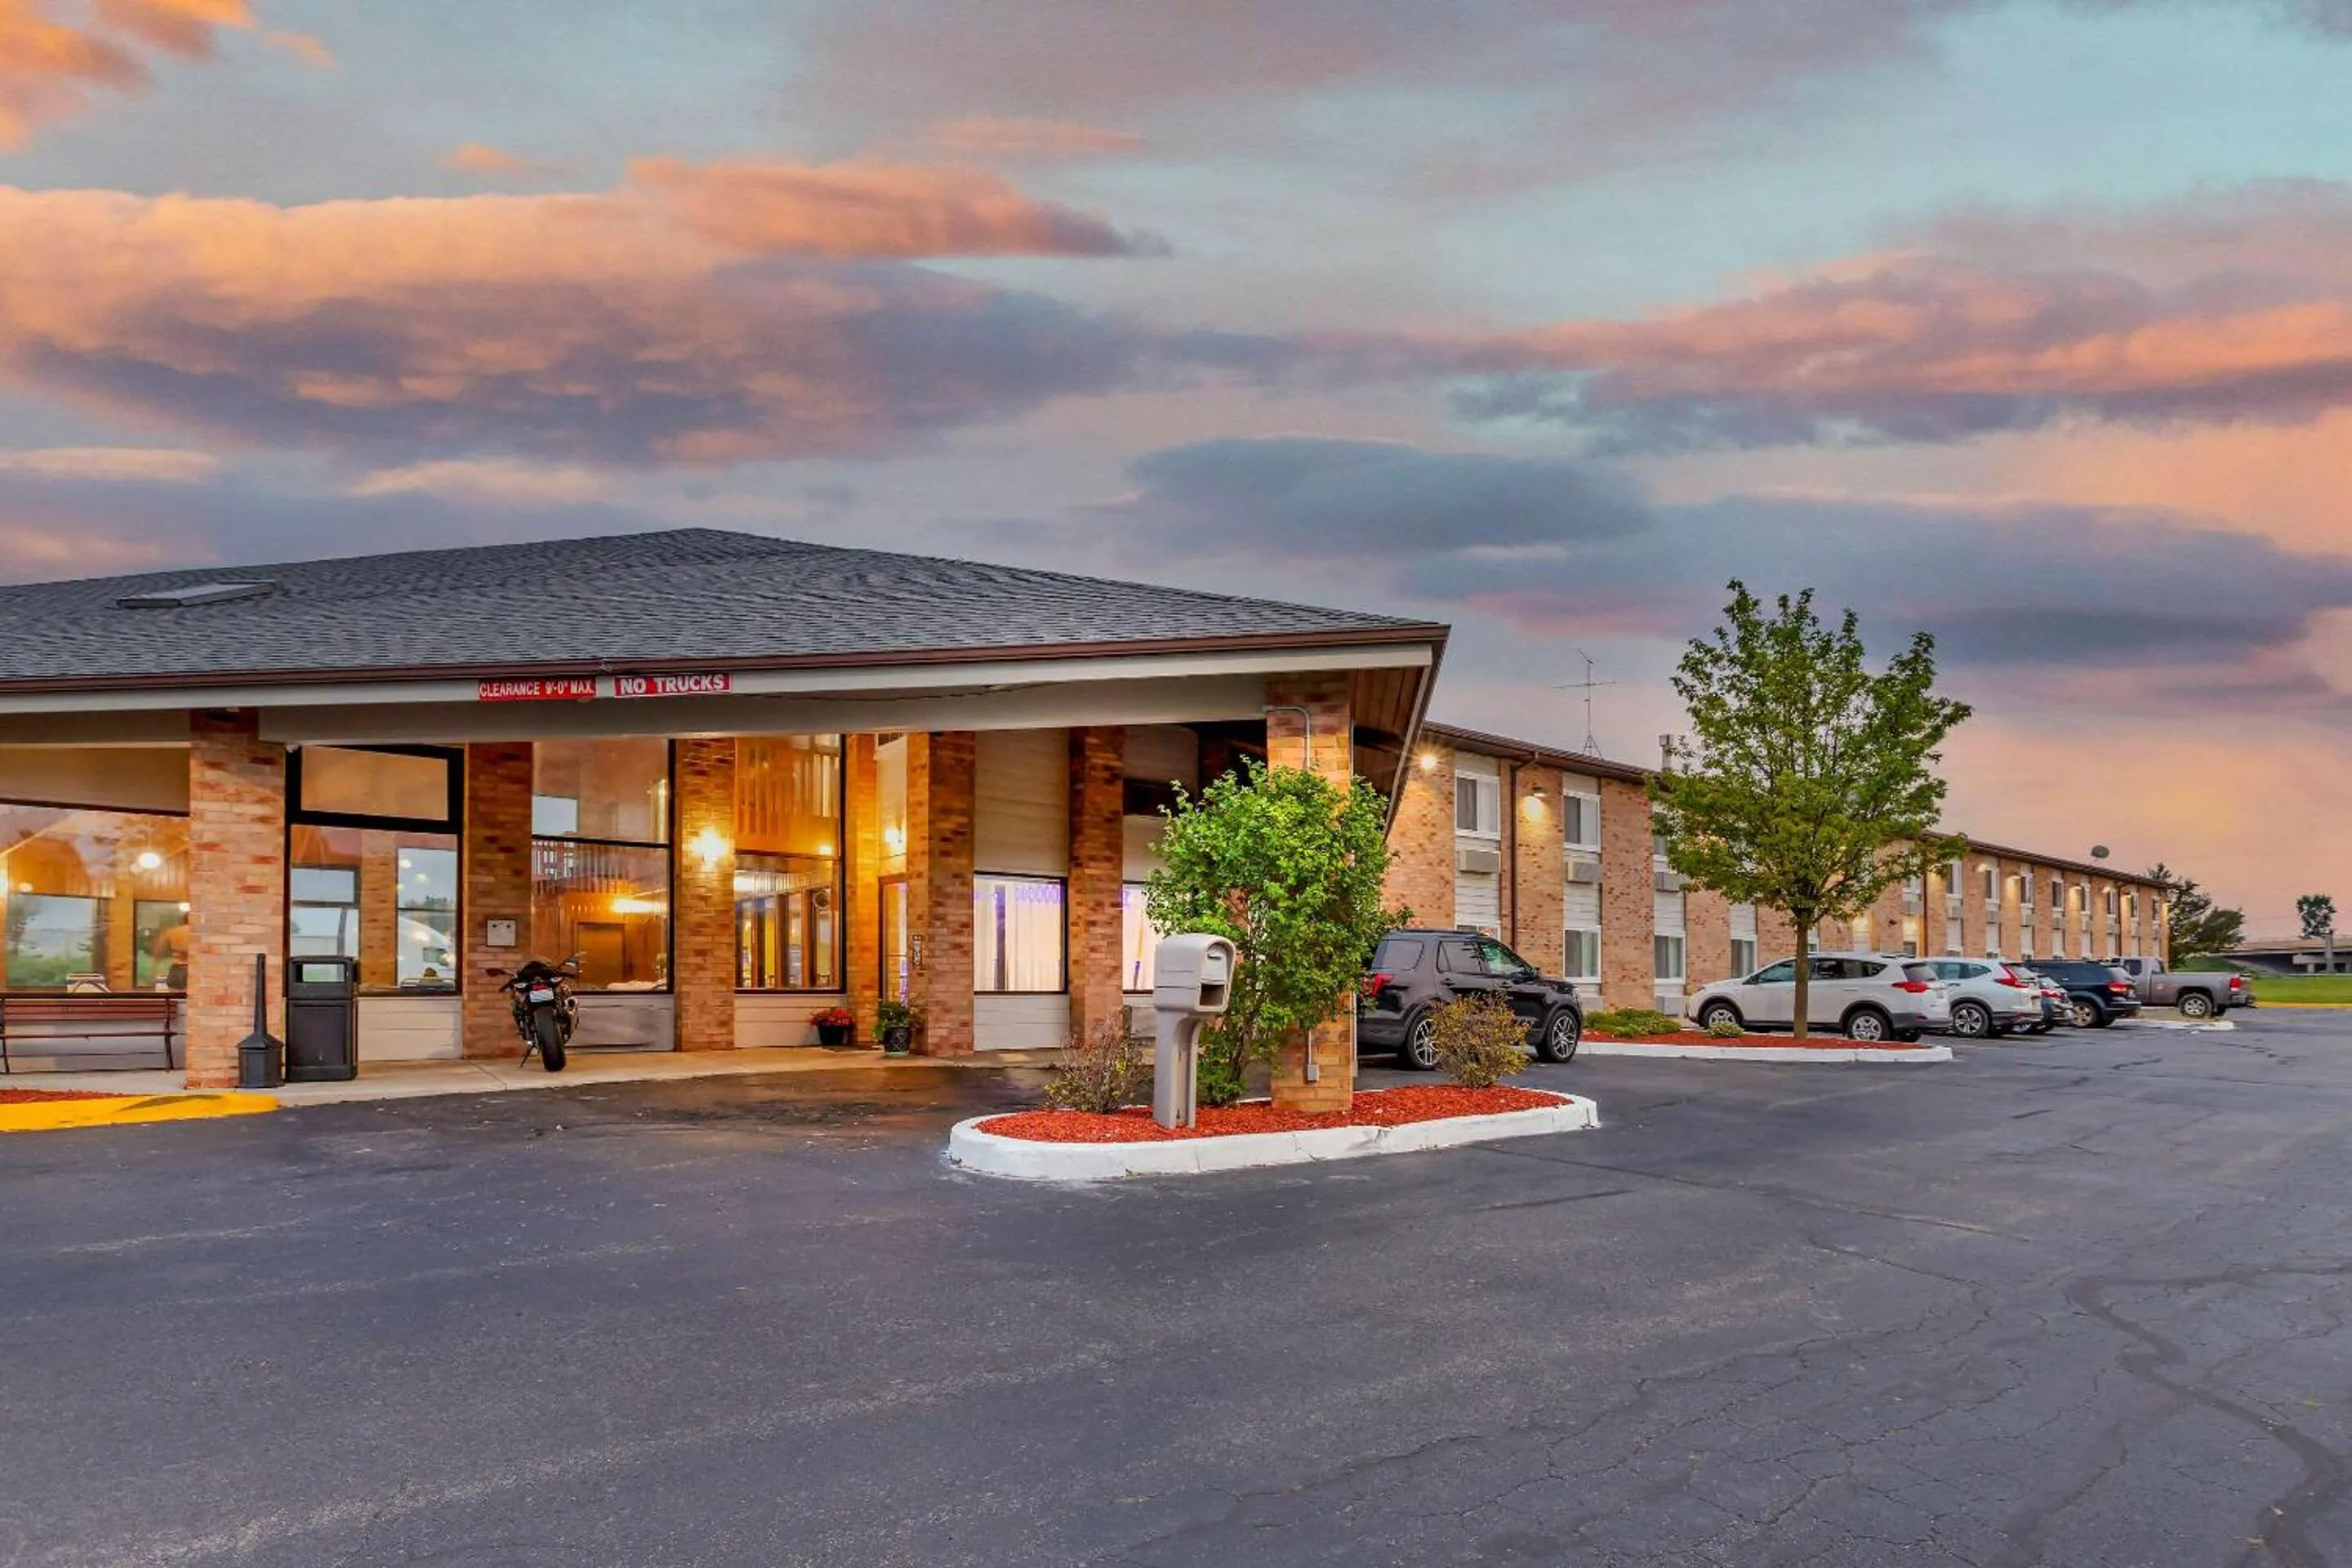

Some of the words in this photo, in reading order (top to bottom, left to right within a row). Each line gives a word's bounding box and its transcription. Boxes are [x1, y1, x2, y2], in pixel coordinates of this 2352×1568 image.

[479, 681, 540, 697] CLEARANCE
[620, 677, 647, 693] NO
[653, 674, 724, 693] TRUCKS
